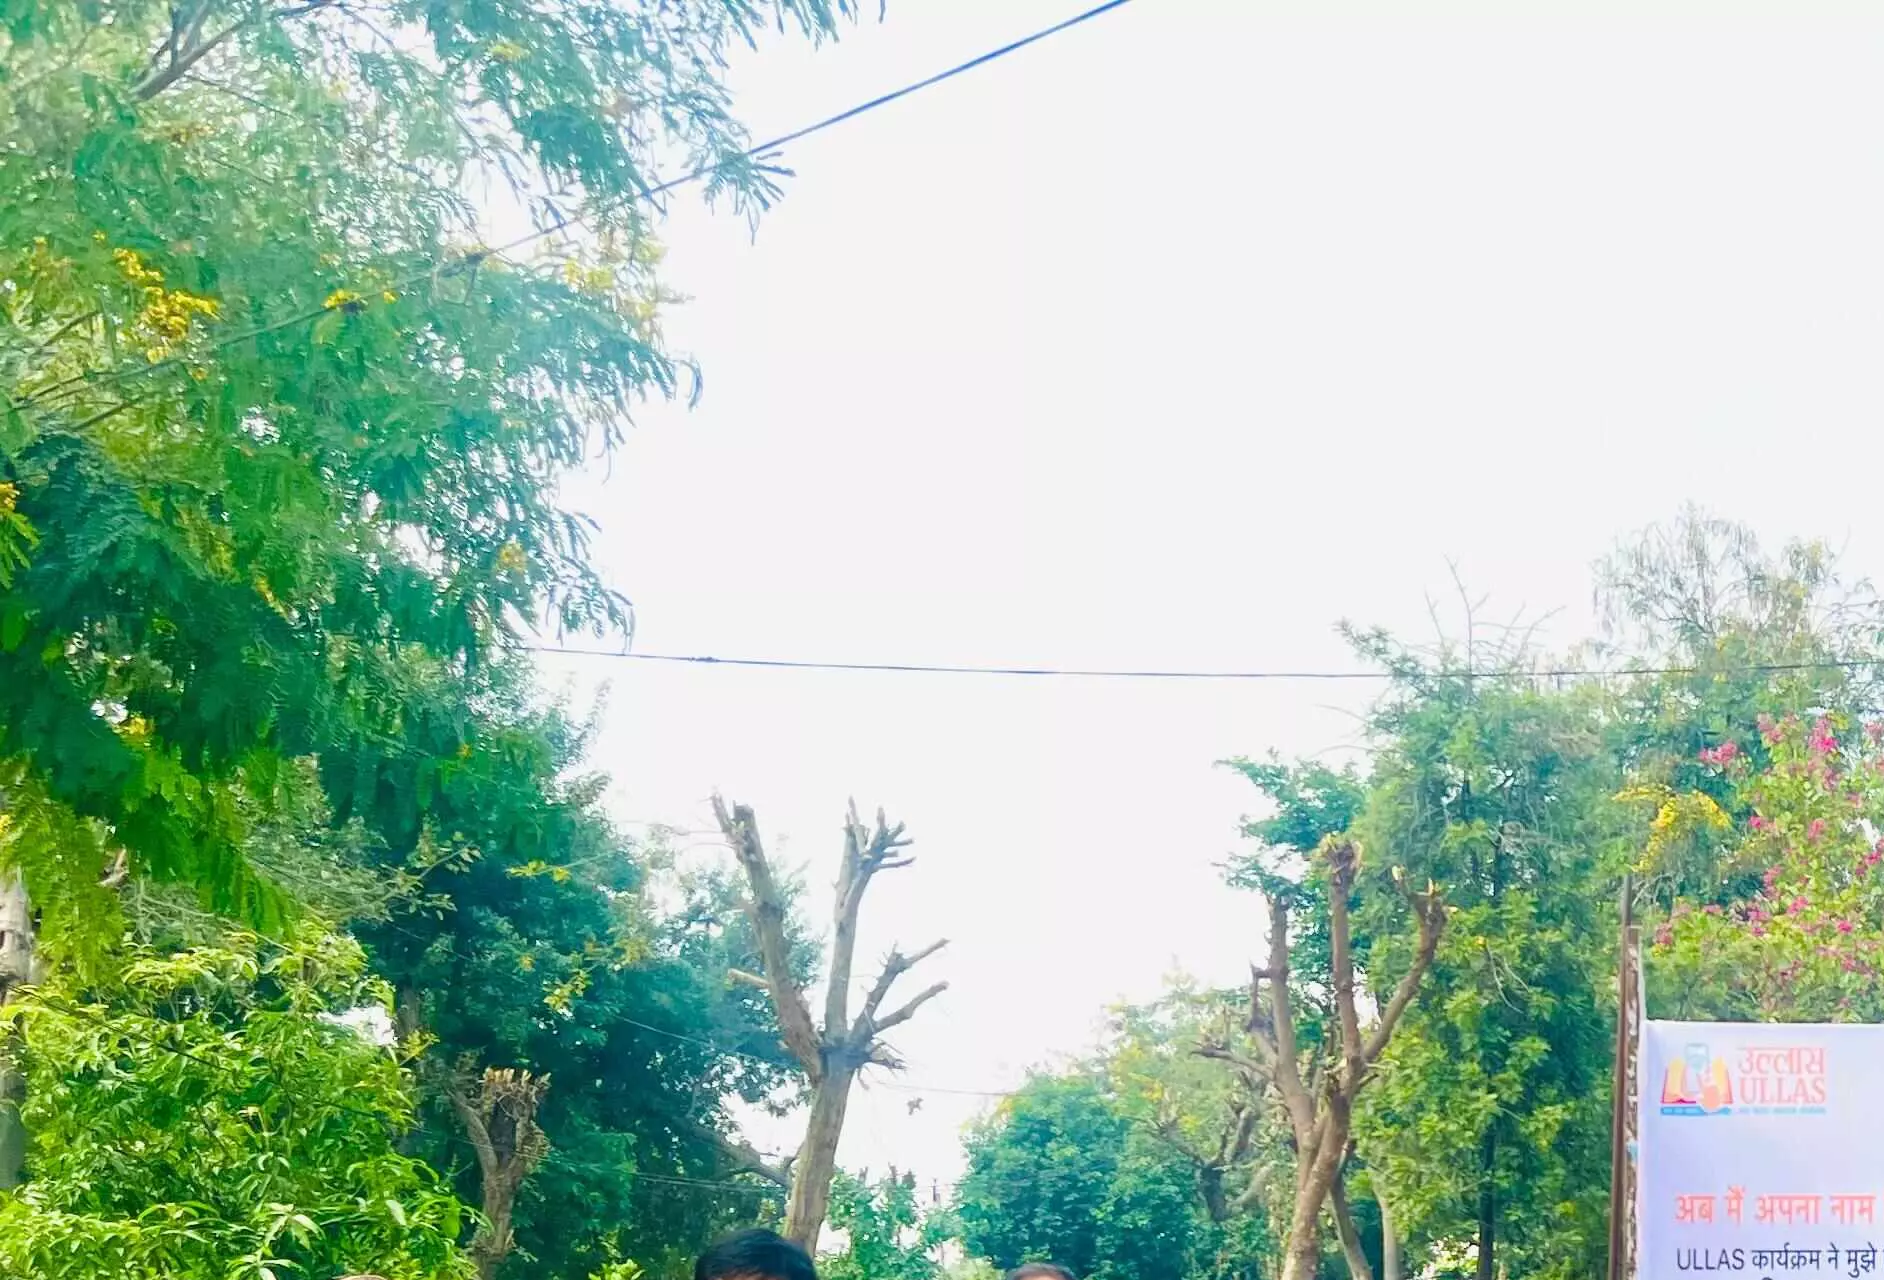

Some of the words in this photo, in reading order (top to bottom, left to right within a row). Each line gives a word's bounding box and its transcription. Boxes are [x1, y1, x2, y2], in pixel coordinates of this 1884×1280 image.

[1739, 1077, 1826, 1104] ULLAS
[1676, 1194, 1715, 1223] अब
[1724, 1184, 1745, 1224] मैं
[1755, 1194, 1822, 1224] अपना
[1829, 1194, 1876, 1223] नाम
[1676, 1248, 1745, 1270] ULLAS
[1752, 1242, 1822, 1271] कार्यक्रम
[1827, 1242, 1840, 1270] ने
[1845, 1241, 1878, 1278] मुझे
